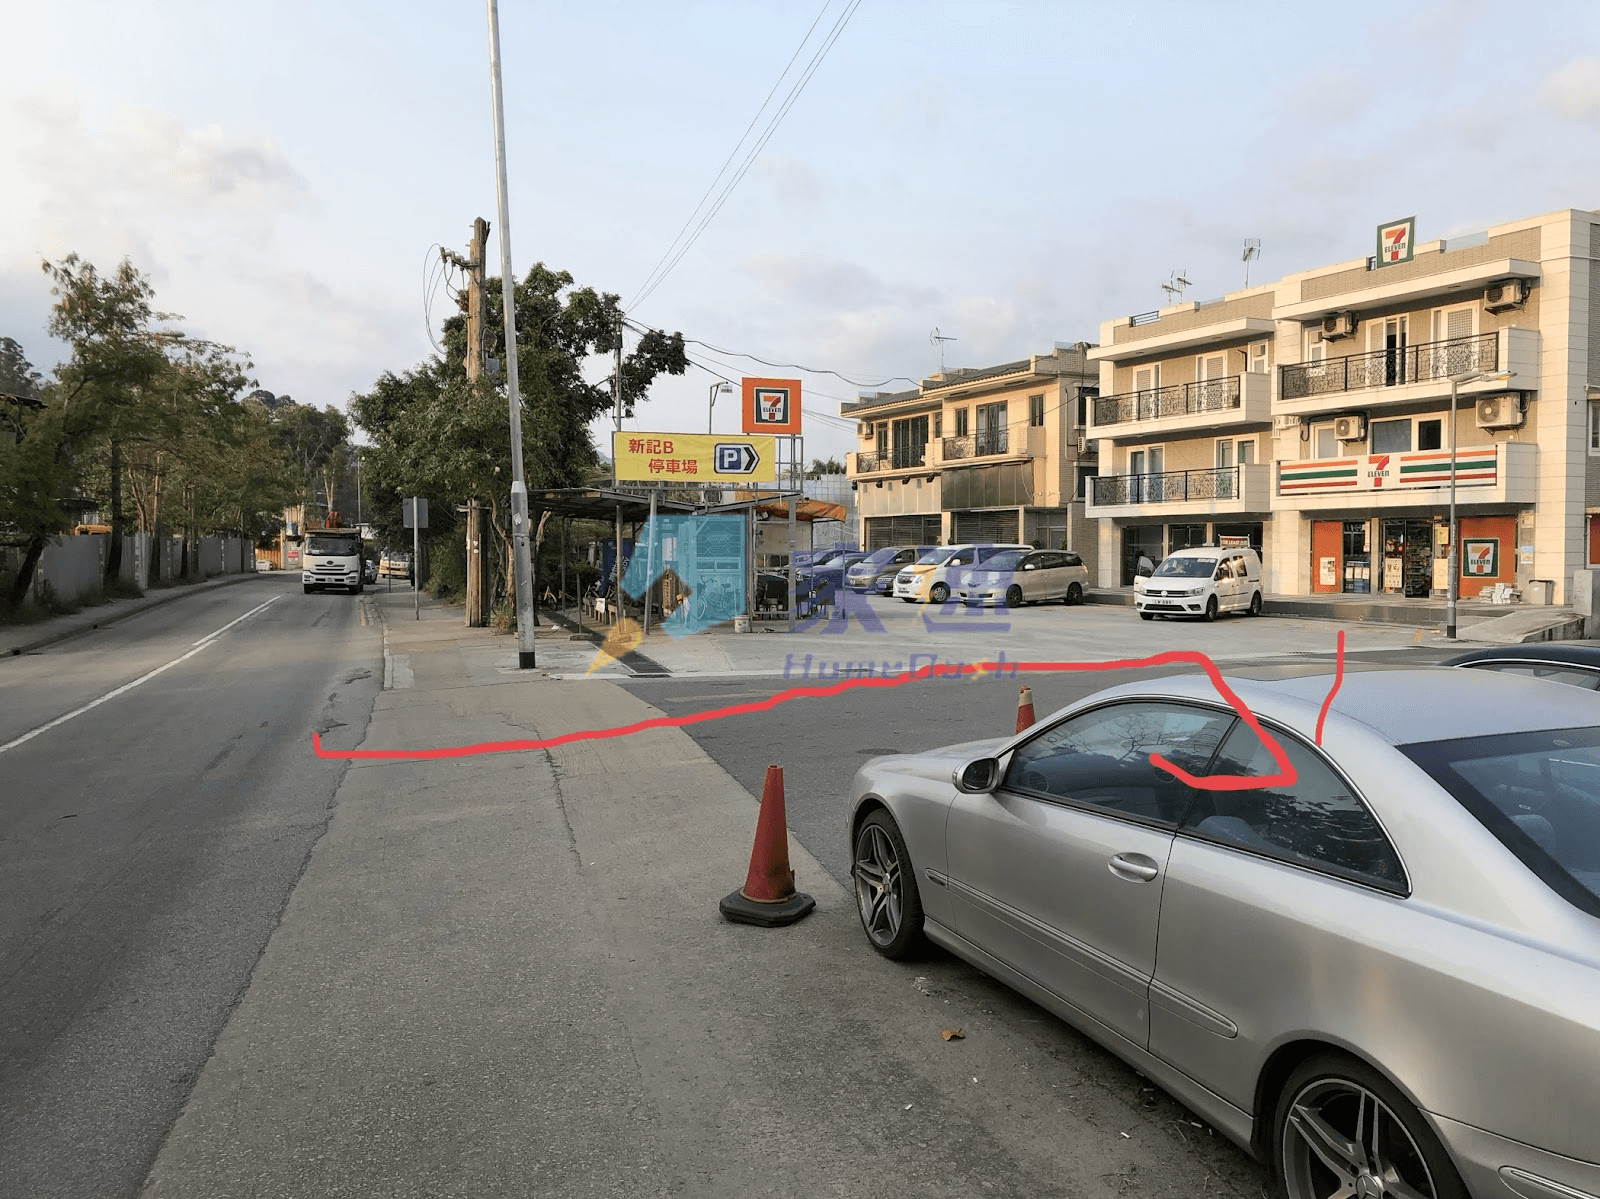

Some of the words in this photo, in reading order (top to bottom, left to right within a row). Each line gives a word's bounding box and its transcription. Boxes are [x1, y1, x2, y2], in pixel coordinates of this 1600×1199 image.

[1385, 227, 1406, 261] 7
[763, 395, 781, 420] 7
[628, 438, 674, 454] 新記B
[648, 458, 698, 475] 停車場
[723, 450, 738, 468] P
[1368, 455, 1390, 487] 7
[1470, 546, 1490, 573] 7
